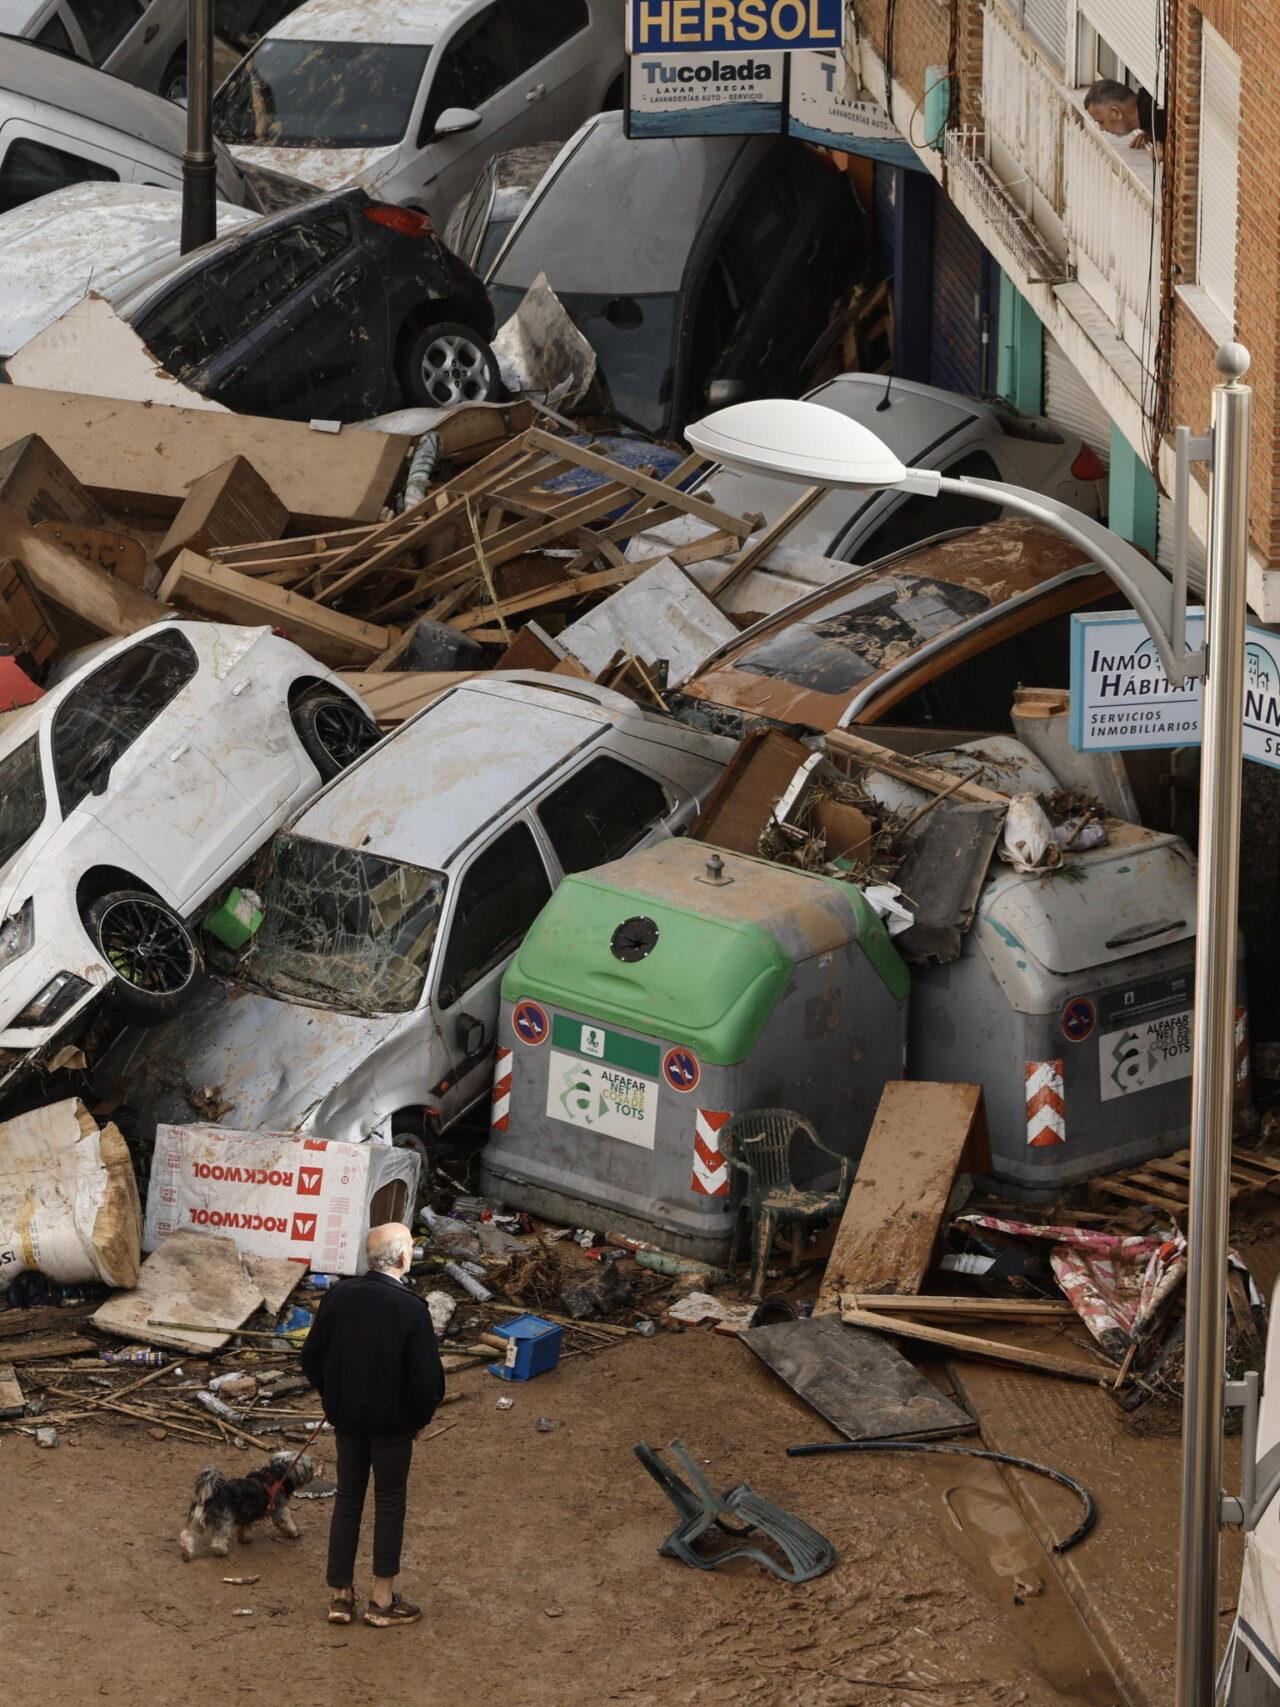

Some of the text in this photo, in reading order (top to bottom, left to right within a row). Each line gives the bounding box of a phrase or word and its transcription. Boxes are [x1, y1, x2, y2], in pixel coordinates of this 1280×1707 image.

[639, 0, 836, 44] HERSOL
[641, 59, 772, 84] Tucolada
[656, 86, 695, 94] LAVAR
[715, 84, 755, 92] SECAR
[650, 95, 700, 103] LAVANDERÍAS
[834, 97, 867, 112] LAVAR
[872, 106, 878, 114] Y
[871, 119, 889, 130] AUTO
[1090, 649, 1152, 673] INMO
[1091, 710, 1162, 724] SERVICIOS
[1090, 721, 1198, 737] INMOBILIARIOS
[1147, 1014, 1189, 1035] ALFAFAR
[1156, 1026, 1174, 1041] NET
[1162, 1043, 1191, 1061] TOTS
[601, 1070, 646, 1093] ALFAFAR
[610, 1082, 630, 1096] NET
[615, 1101, 645, 1121] TOTS
[192, 1162, 294, 1188] ROCKWOOL
[189, 1207, 288, 1233] ROCKWOOL
